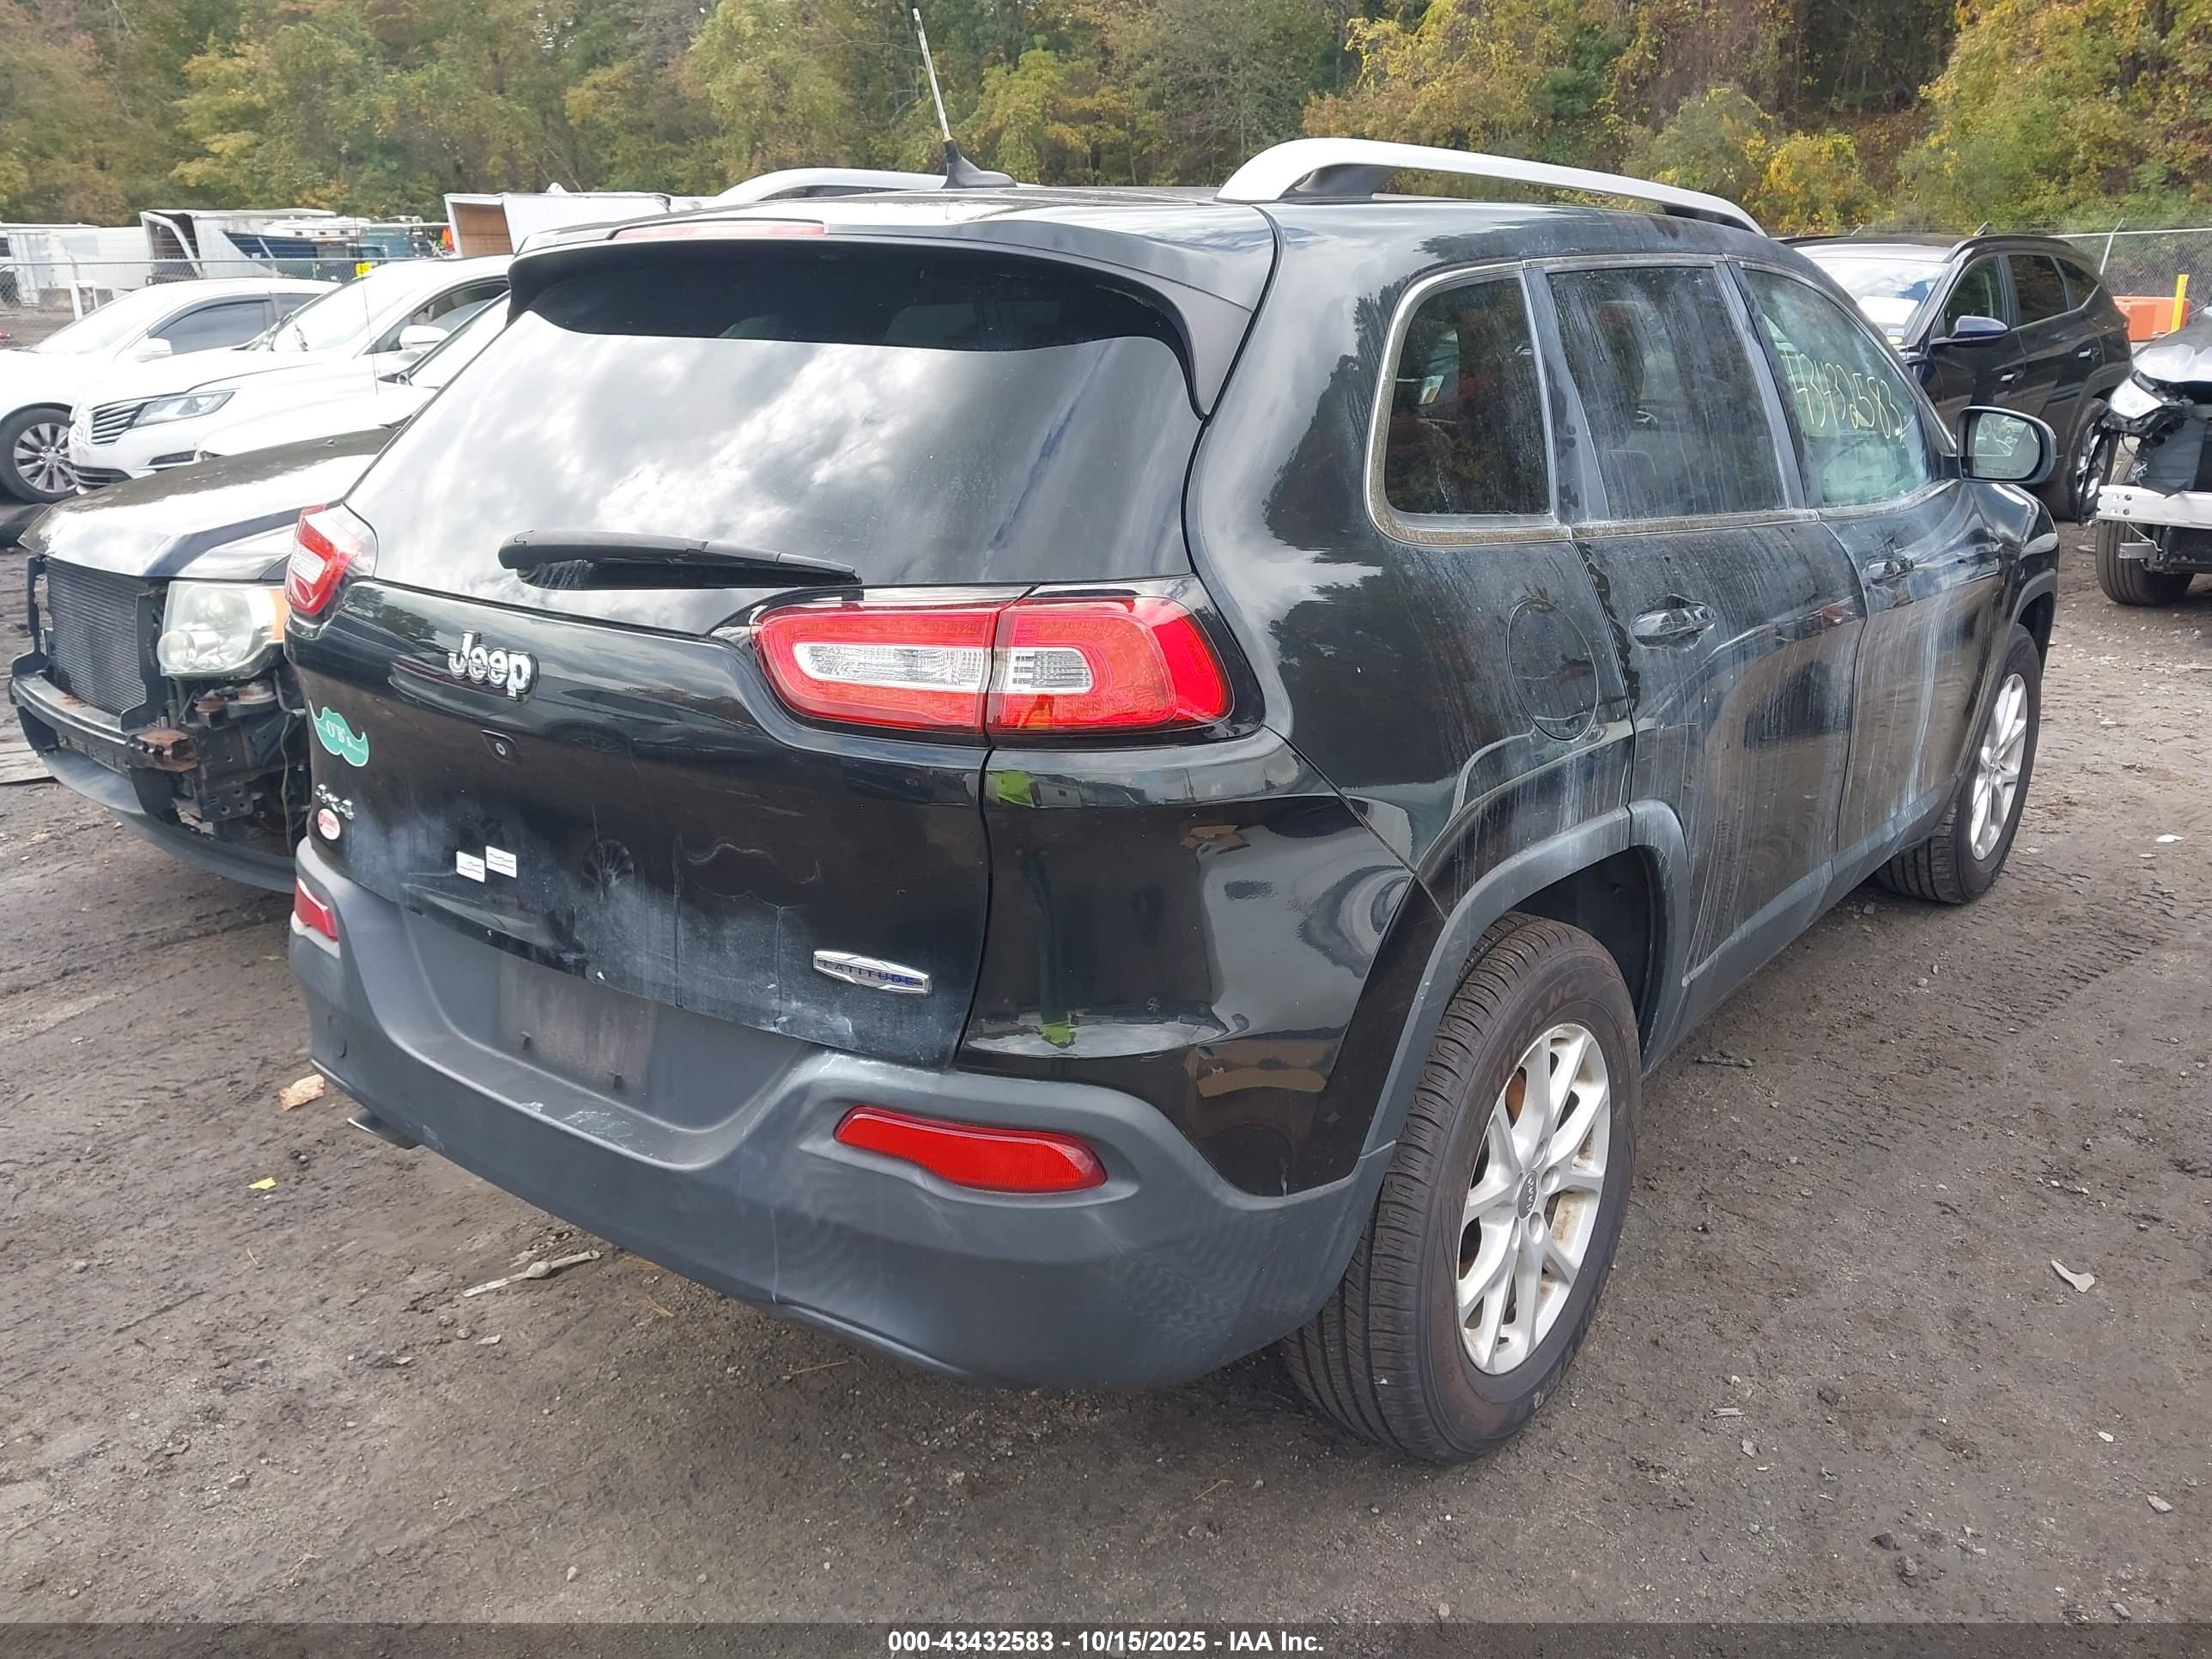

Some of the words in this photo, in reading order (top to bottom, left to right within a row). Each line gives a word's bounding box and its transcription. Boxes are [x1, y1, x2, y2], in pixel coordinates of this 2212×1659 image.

[1784, 349, 1904, 444] 43432583
[447, 630, 539, 701] Jeep
[821, 957, 919, 988] LATITUDE
